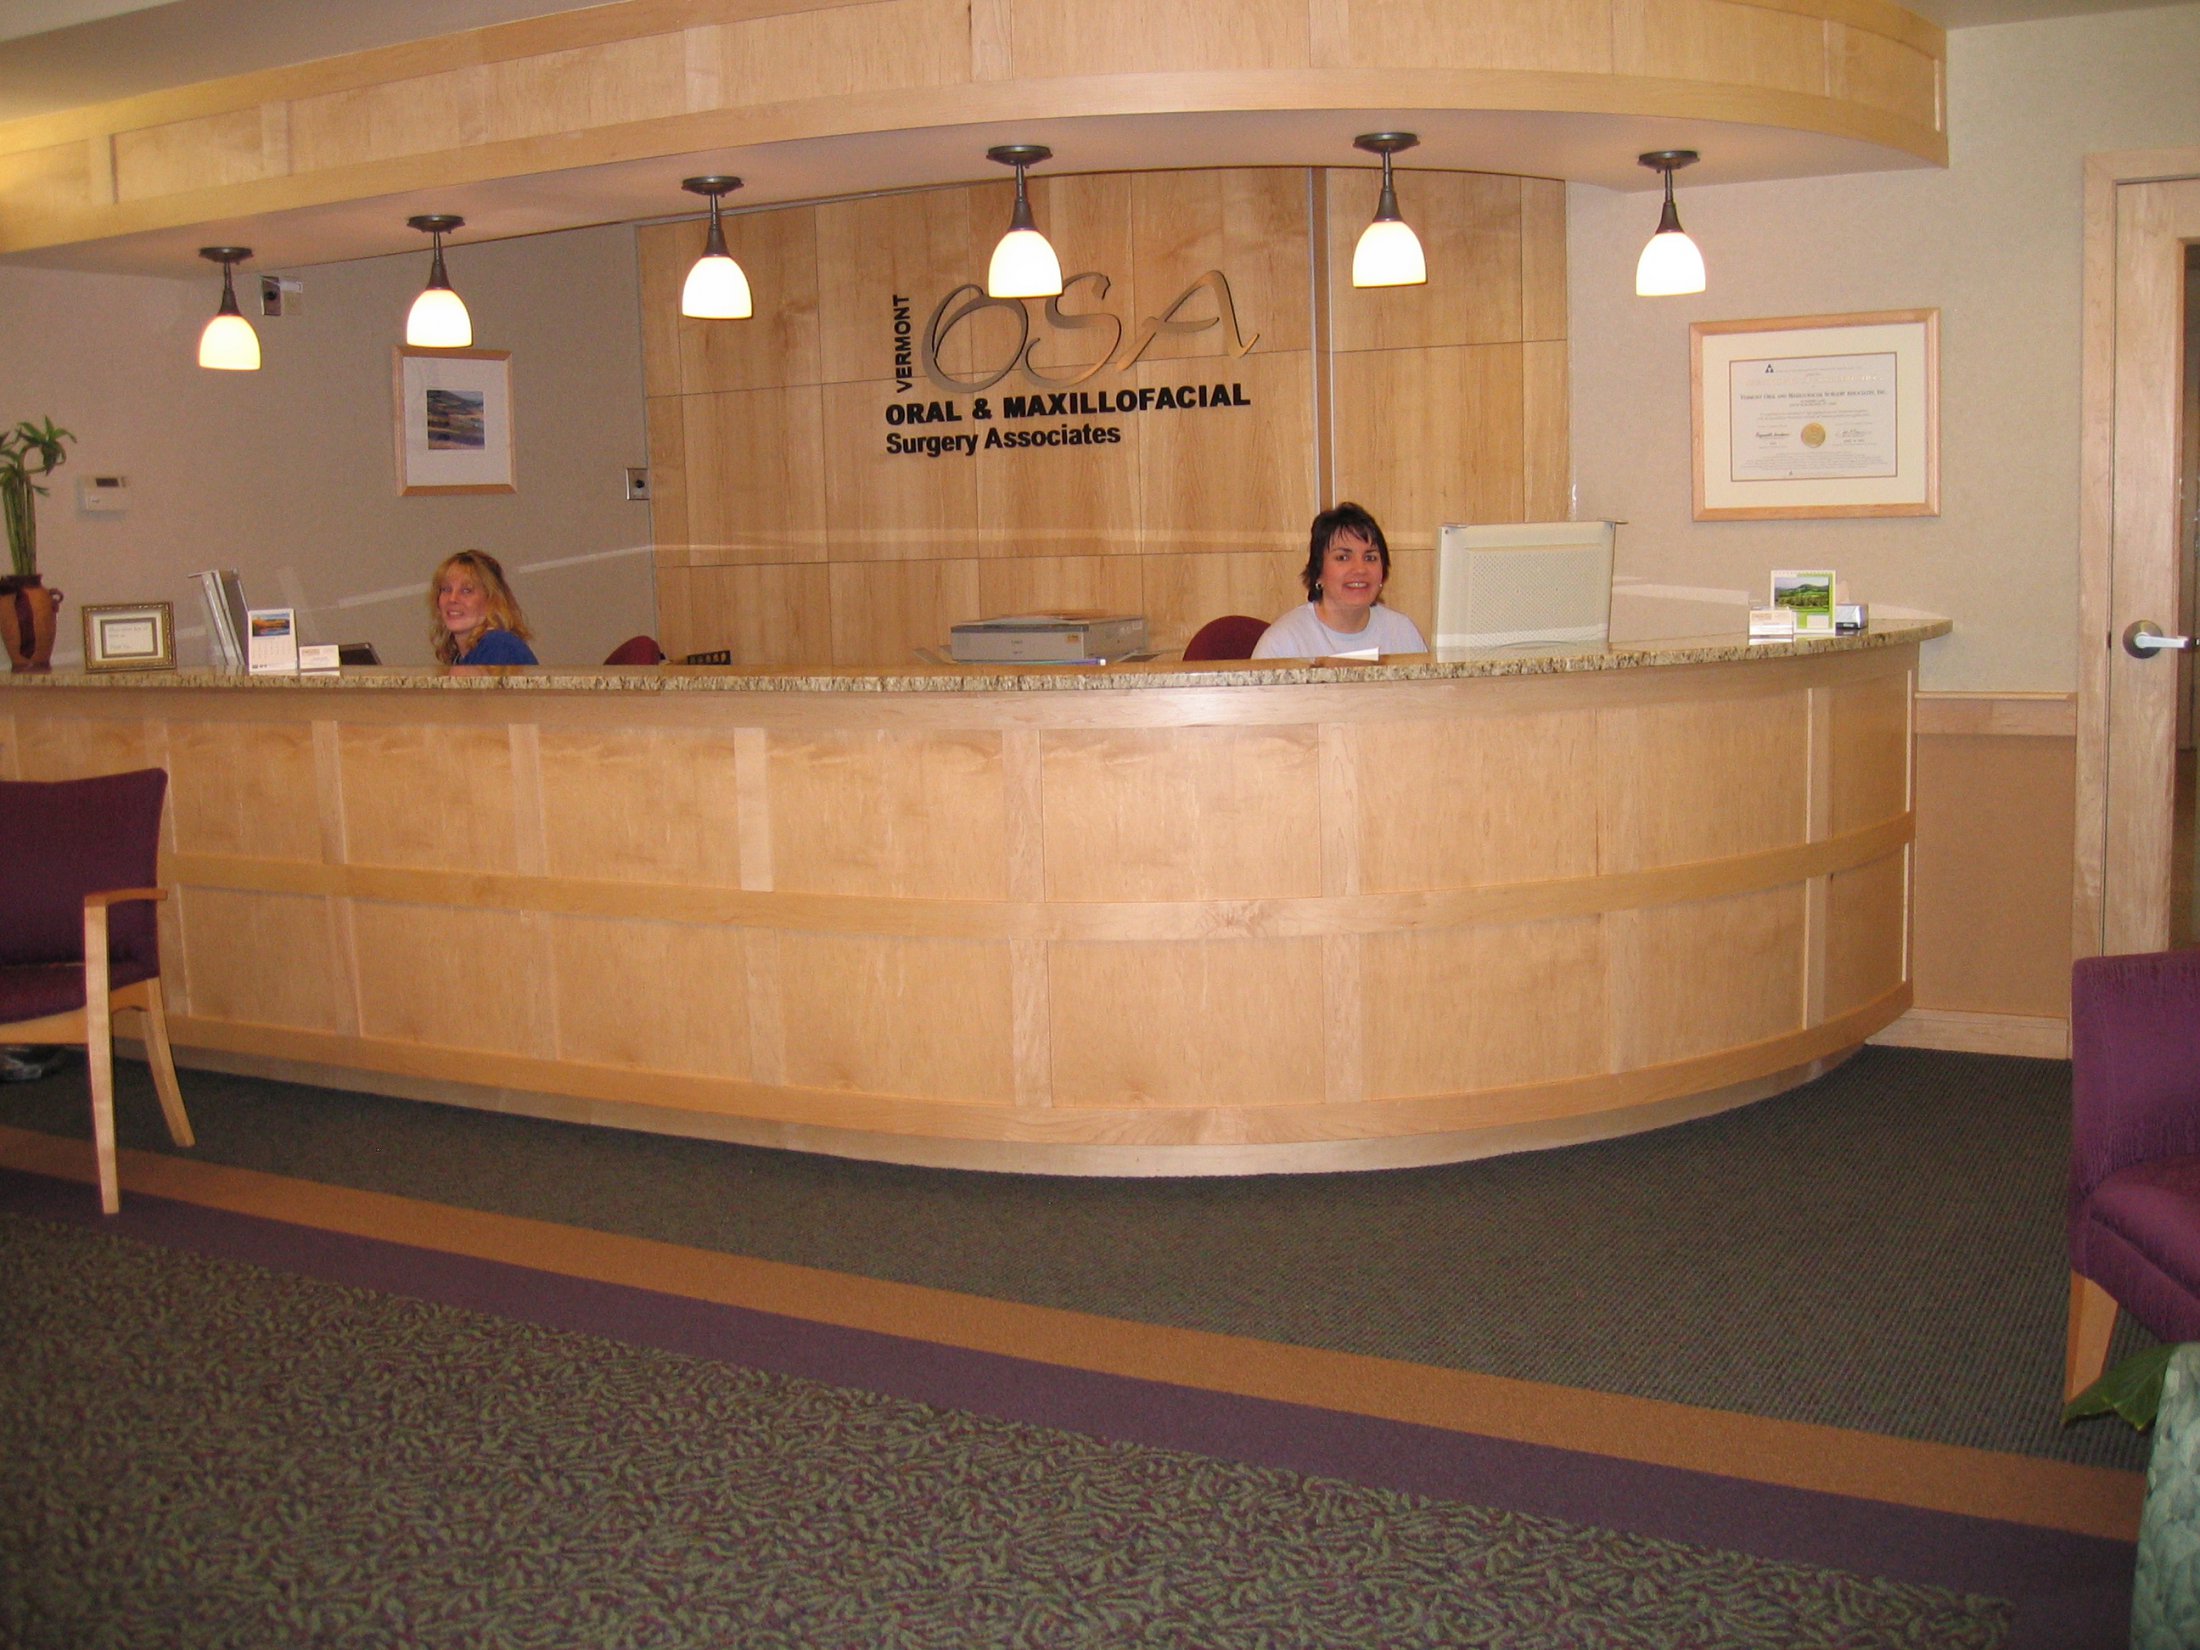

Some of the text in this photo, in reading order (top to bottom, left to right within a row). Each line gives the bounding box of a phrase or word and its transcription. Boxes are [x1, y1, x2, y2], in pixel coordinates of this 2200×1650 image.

[892, 294, 913, 393] VERMONT
[885, 383, 1251, 426] ORAL & MAXILLOFACIAL
[886, 423, 1121, 458] Surgery Associates
